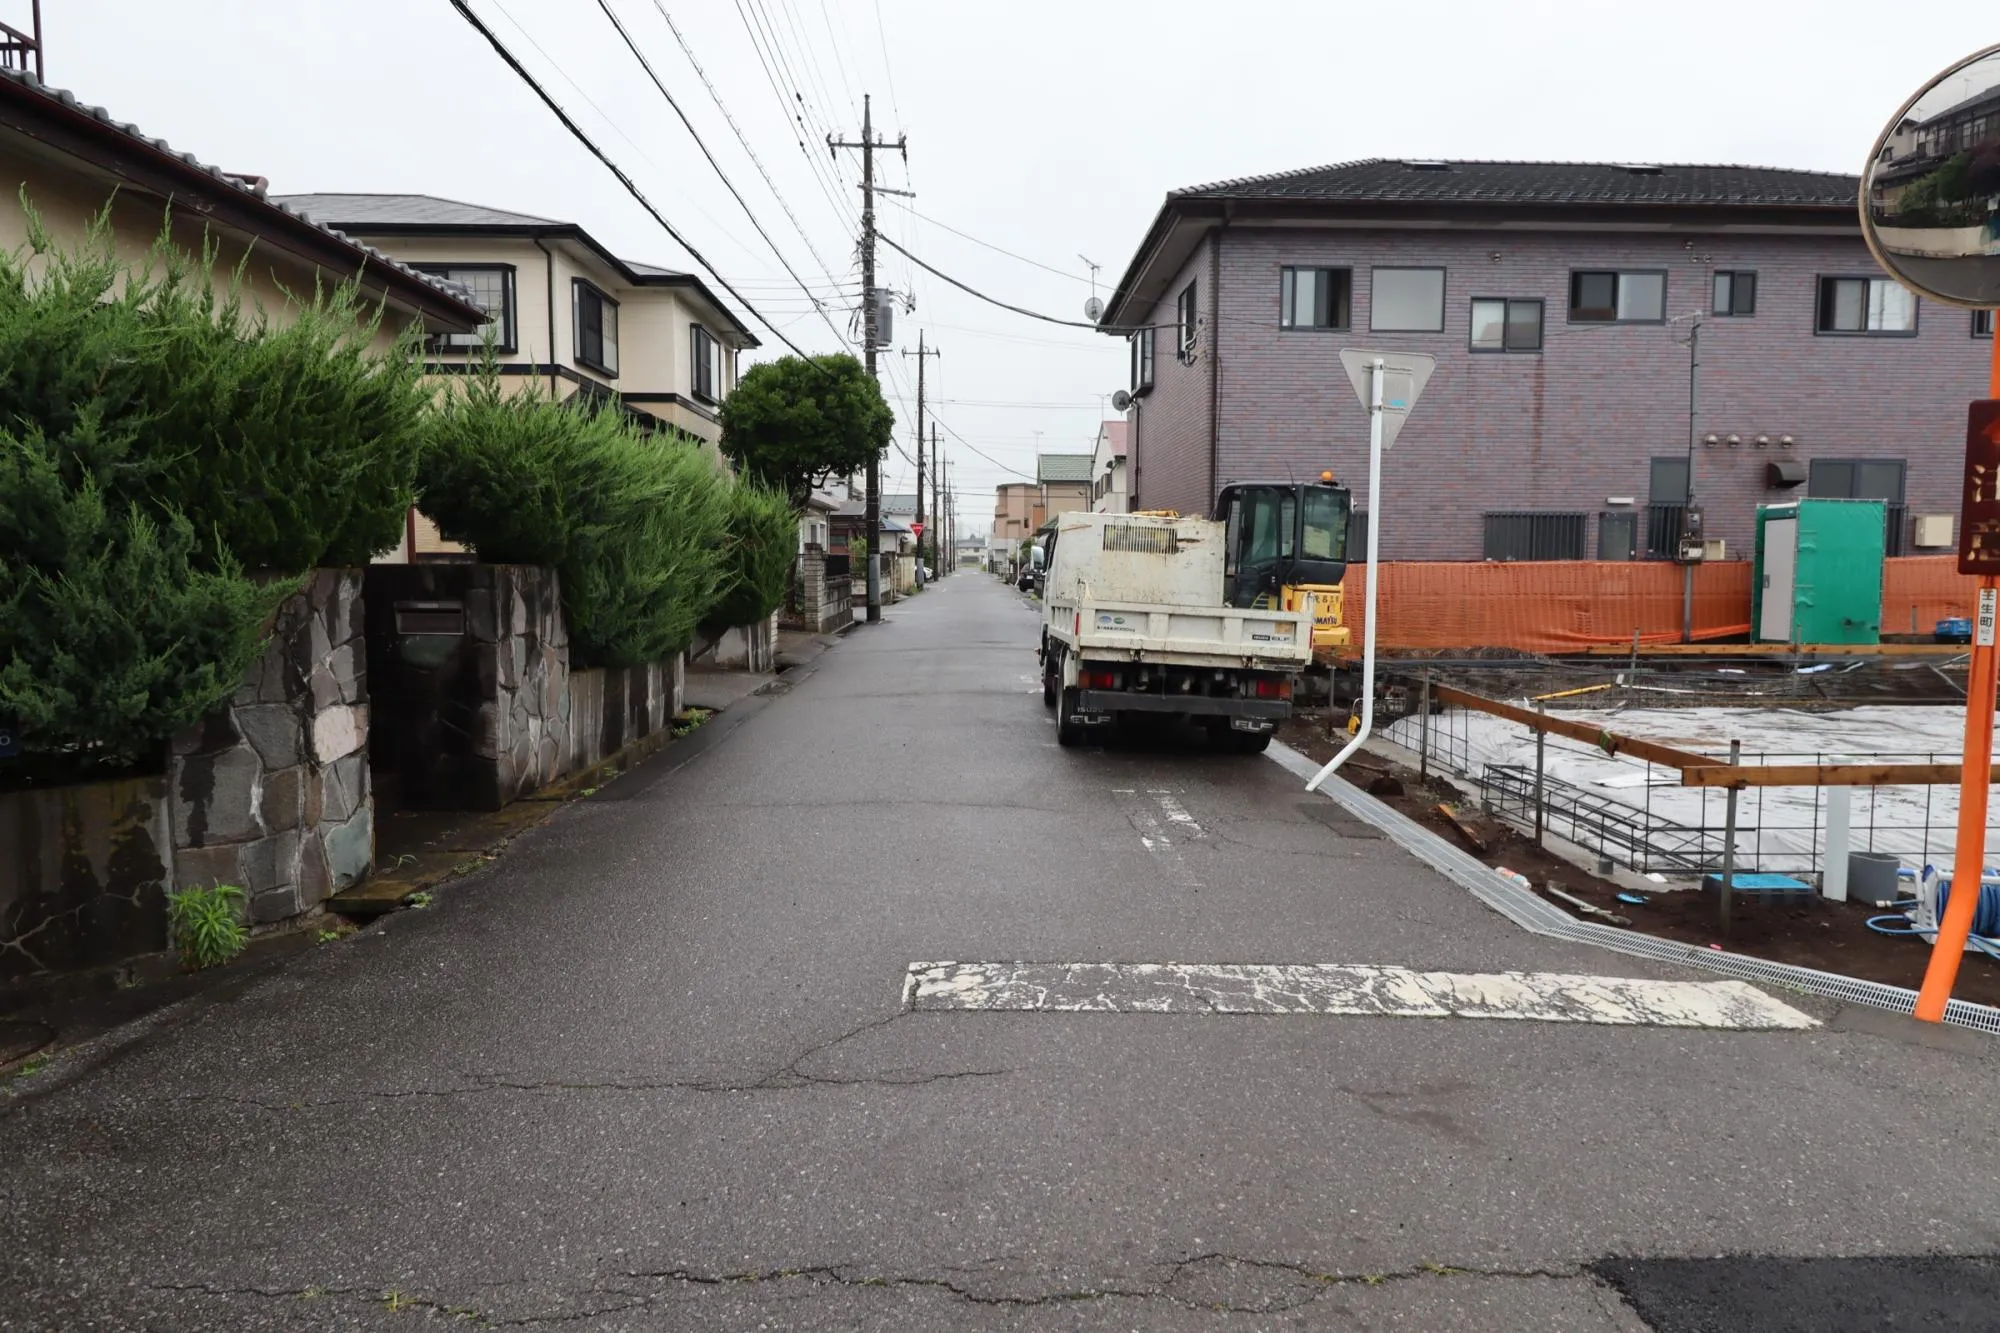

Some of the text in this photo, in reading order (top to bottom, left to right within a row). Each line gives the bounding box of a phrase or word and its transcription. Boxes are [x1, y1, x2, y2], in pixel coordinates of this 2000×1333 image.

[1313, 615, 1337, 624] OMATSU
[1980, 590, 1995, 627] 壬生町
